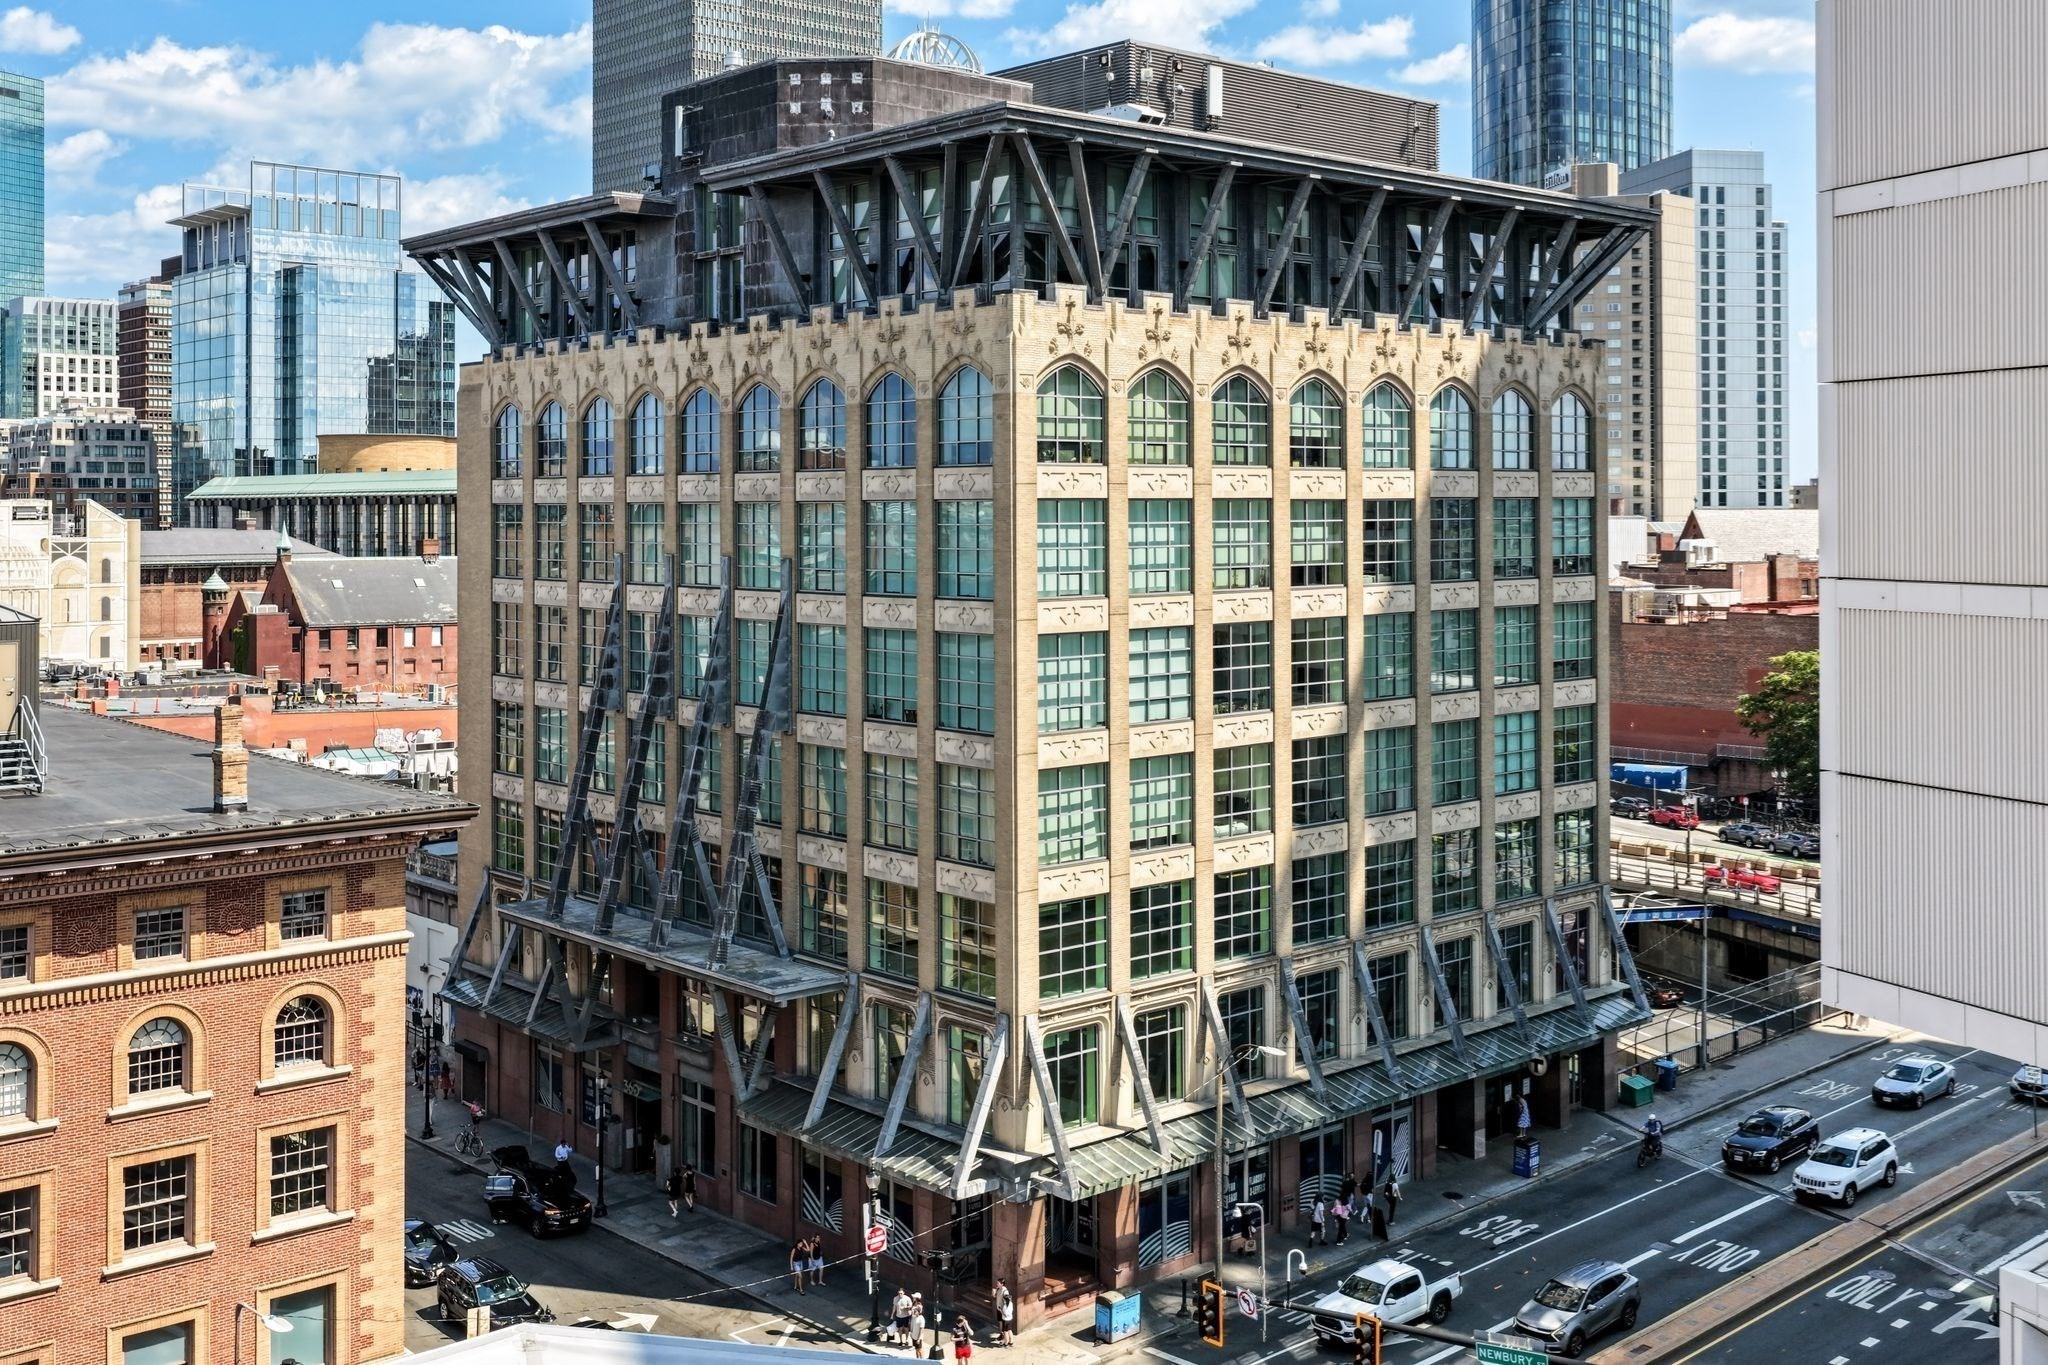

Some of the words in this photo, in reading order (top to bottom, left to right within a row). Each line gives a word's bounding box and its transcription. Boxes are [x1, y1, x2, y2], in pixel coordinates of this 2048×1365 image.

[1545, 173, 1569, 189] Hilton
[433, 1218, 495, 1247] ONL
[1459, 1215, 1539, 1245] BUS
[1668, 1239, 1760, 1273] ONLY
[1825, 1275, 1924, 1314] ONLY
[1479, 1347, 1533, 1365] NEWBURY
